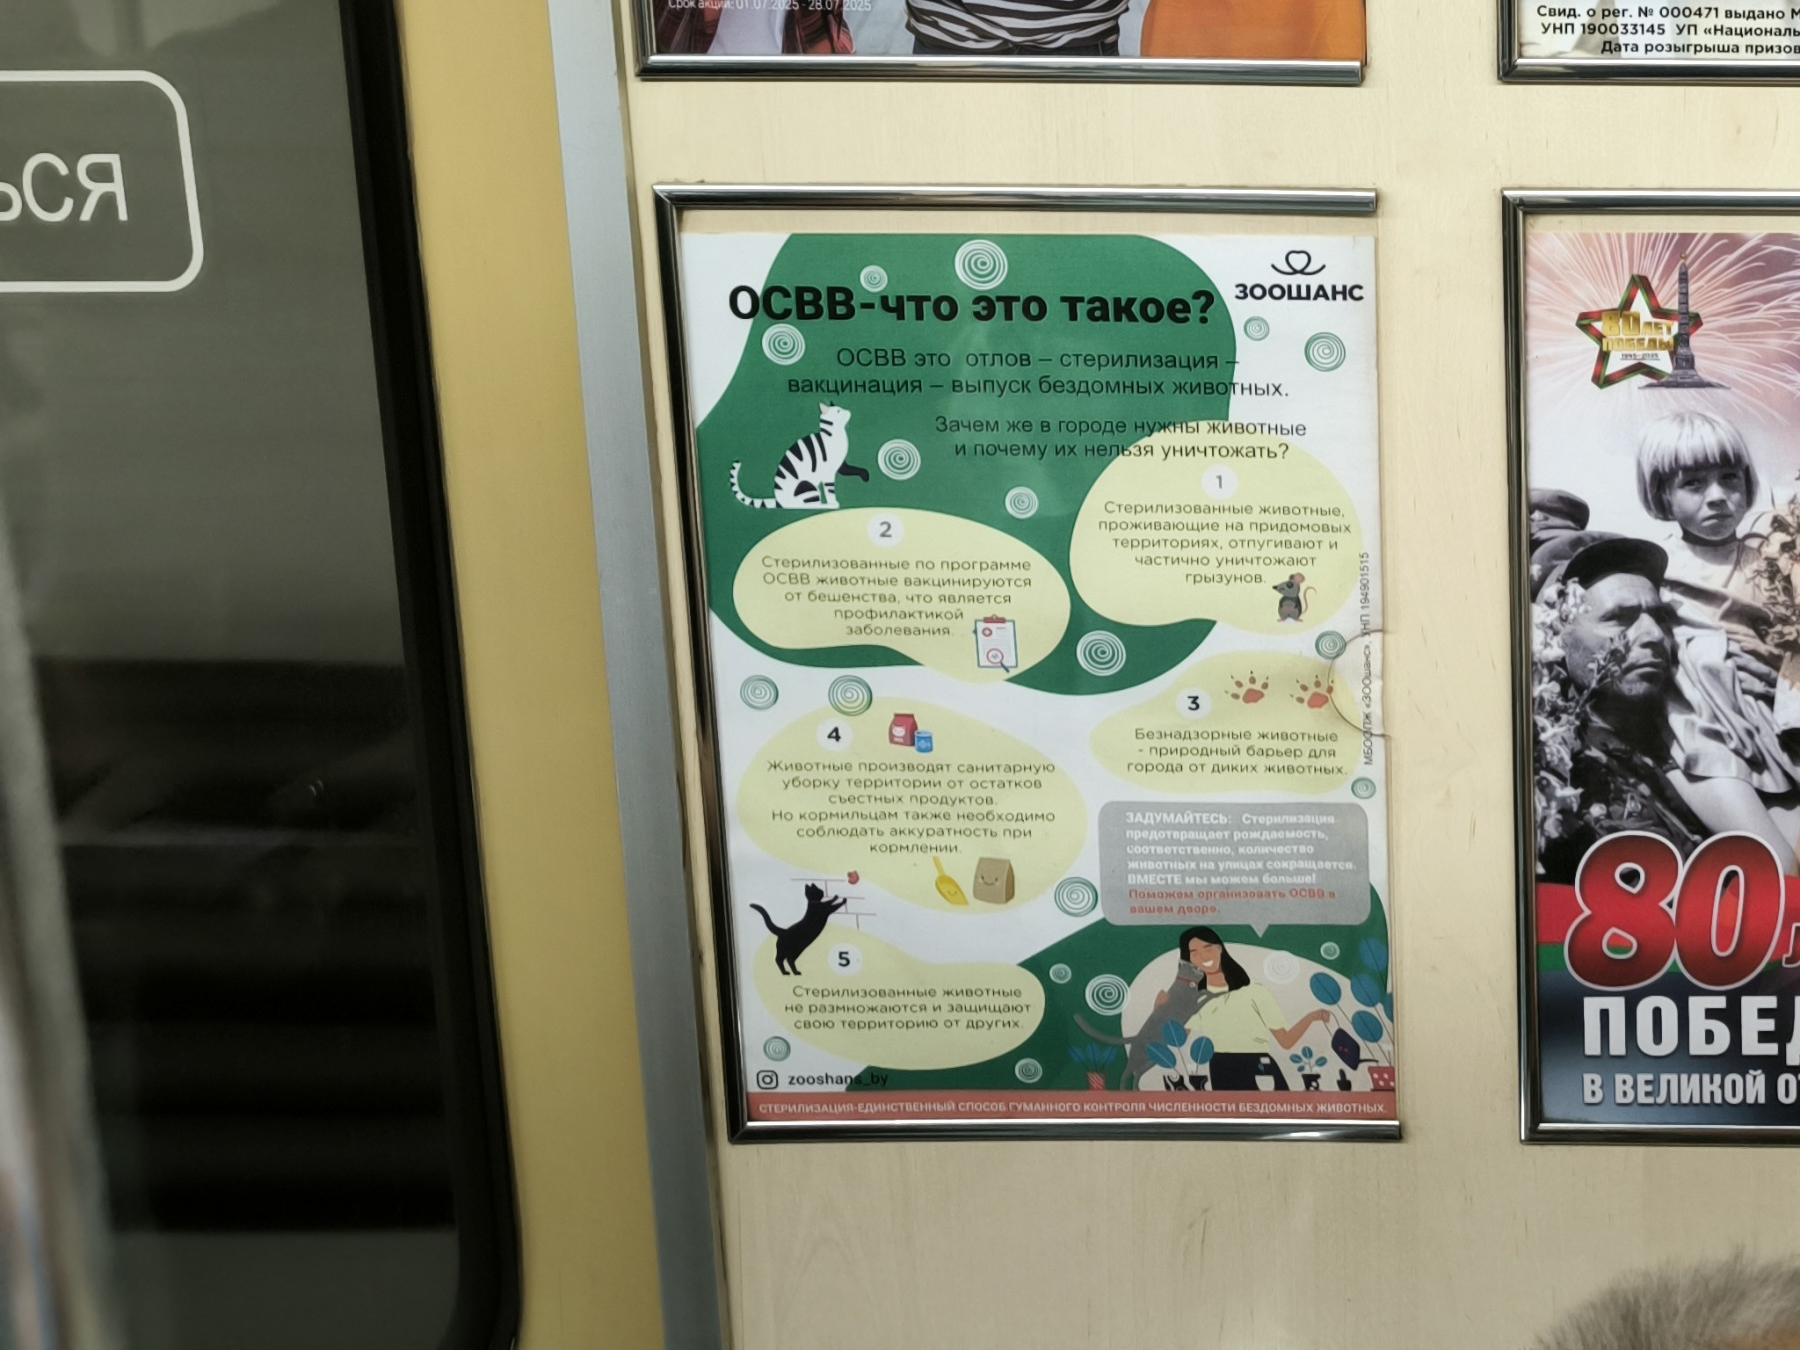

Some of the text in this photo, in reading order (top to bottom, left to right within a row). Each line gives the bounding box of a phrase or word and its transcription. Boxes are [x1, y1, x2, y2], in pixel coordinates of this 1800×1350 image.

[1601, 40, 1639, 55] Дата
[1644, 43, 1740, 55] розыгрыша
[1234, 284, 1364, 302] ЗООШАНС
[972, 295, 1047, 322] это
[1060, 288, 1214, 324] такое?
[836, 347, 906, 367] ОСВВ
[914, 352, 951, 367] это
[966, 353, 1032, 368] отлов
[1060, 353, 1218, 373] стерилизация
[1215, 474, 1223, 489] 1
[1104, 500, 1344, 517] Стерилизованные животные,
[878, 520, 893, 539] 2
[1187, 695, 1200, 712] 3
[827, 726, 841, 743] 4
[1135, 729, 1338, 743] Безнадзорные животные
[1564, 830, 1785, 990] 80
[837, 950, 850, 968] 5
[788, 1071, 889, 1088] zooshans_by
[1583, 1074, 1605, 1103] В
[1614, 1070, 1766, 1105] ВЕЛИКОЙ
